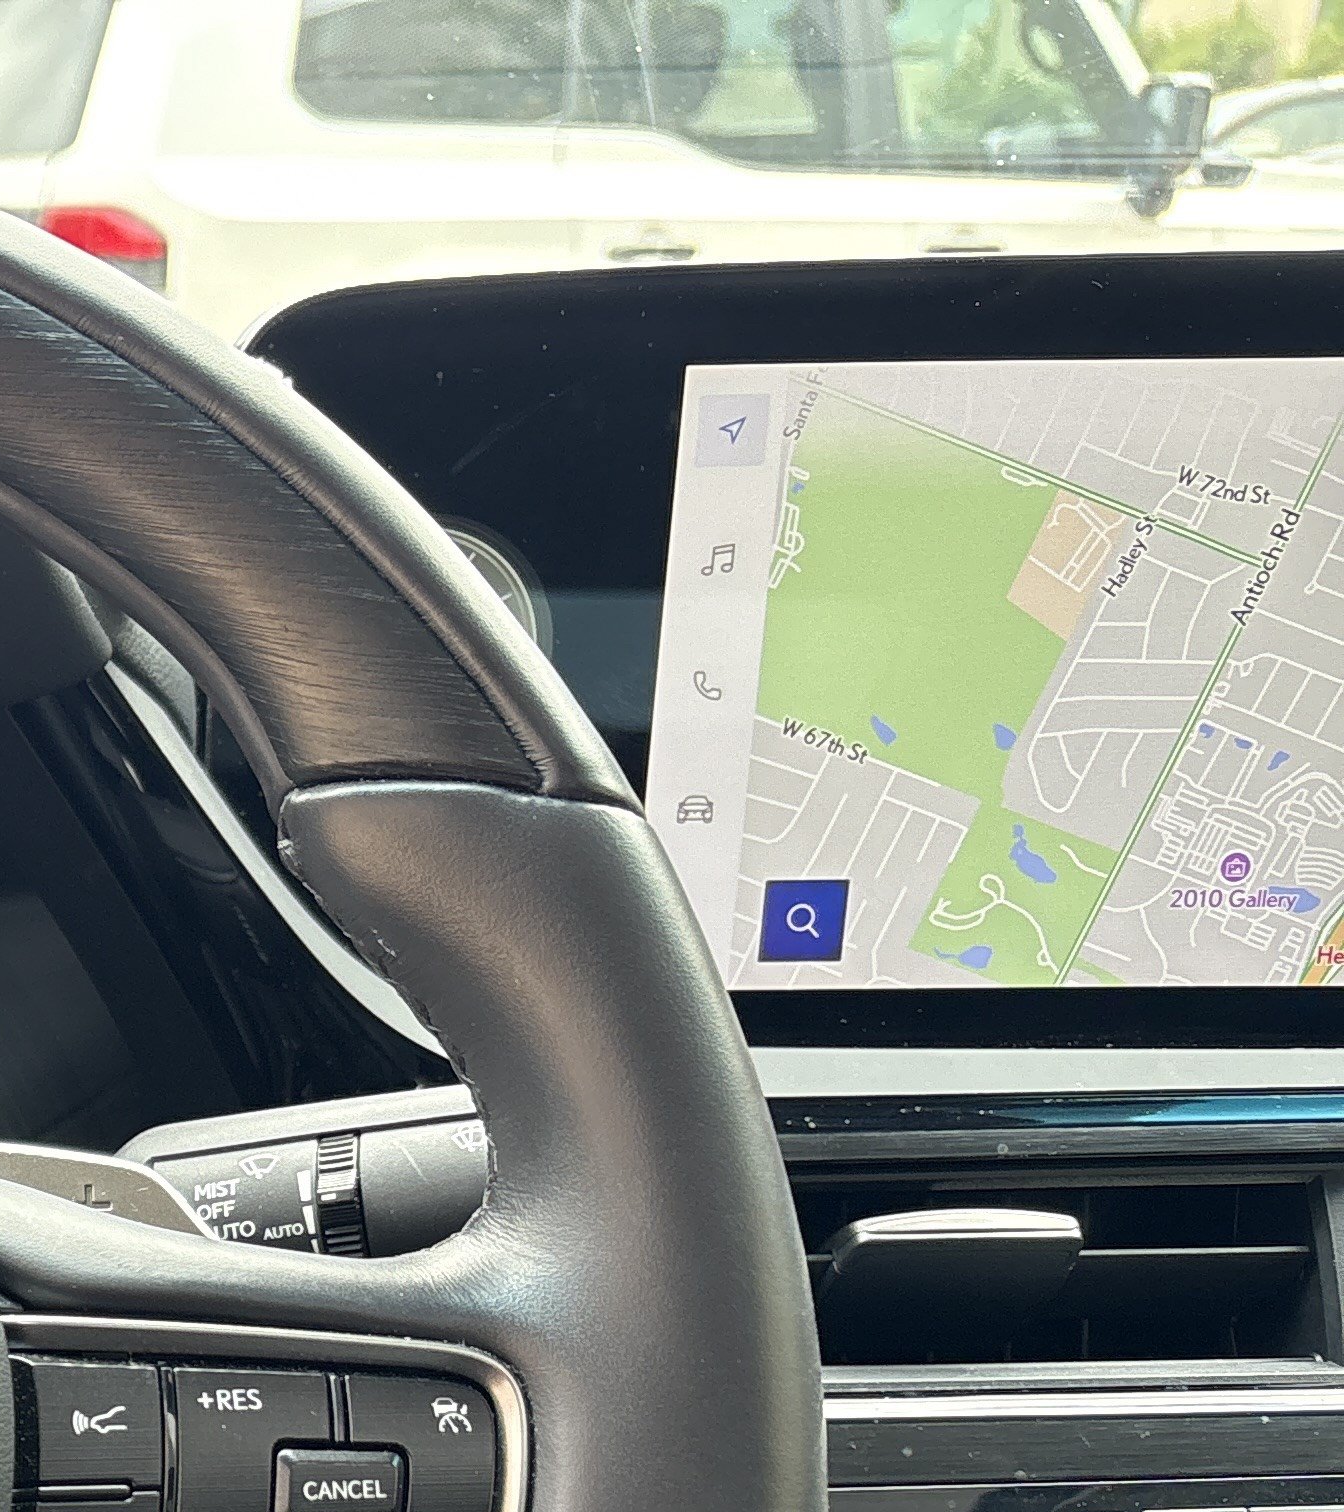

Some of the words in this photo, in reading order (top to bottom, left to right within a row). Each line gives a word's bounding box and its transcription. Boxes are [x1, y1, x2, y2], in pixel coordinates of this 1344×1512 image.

[782, 390, 819, 441] Santa
[1179, 465, 1200, 487] W
[1199, 474, 1249, 504] 72nd
[1249, 485, 1272, 505] St
[1100, 538, 1148, 598] Hadley
[1135, 513, 1158, 536] St
[1230, 545, 1284, 627] Antioch
[1270, 508, 1301, 542] Rd
[782, 717, 805, 738] W
[803, 727, 845, 757] 67th
[847, 742, 868, 765] St
[1169, 889, 1223, 908] 2010
[1229, 889, 1298, 912] Gallery
[194, 1178, 241, 1201] MIST
[196, 1200, 236, 1221] OFF
[213, 1220, 256, 1240] UTO
[263, 1223, 305, 1241] AUTO
[302, 1478, 388, 1502] CANCEL
